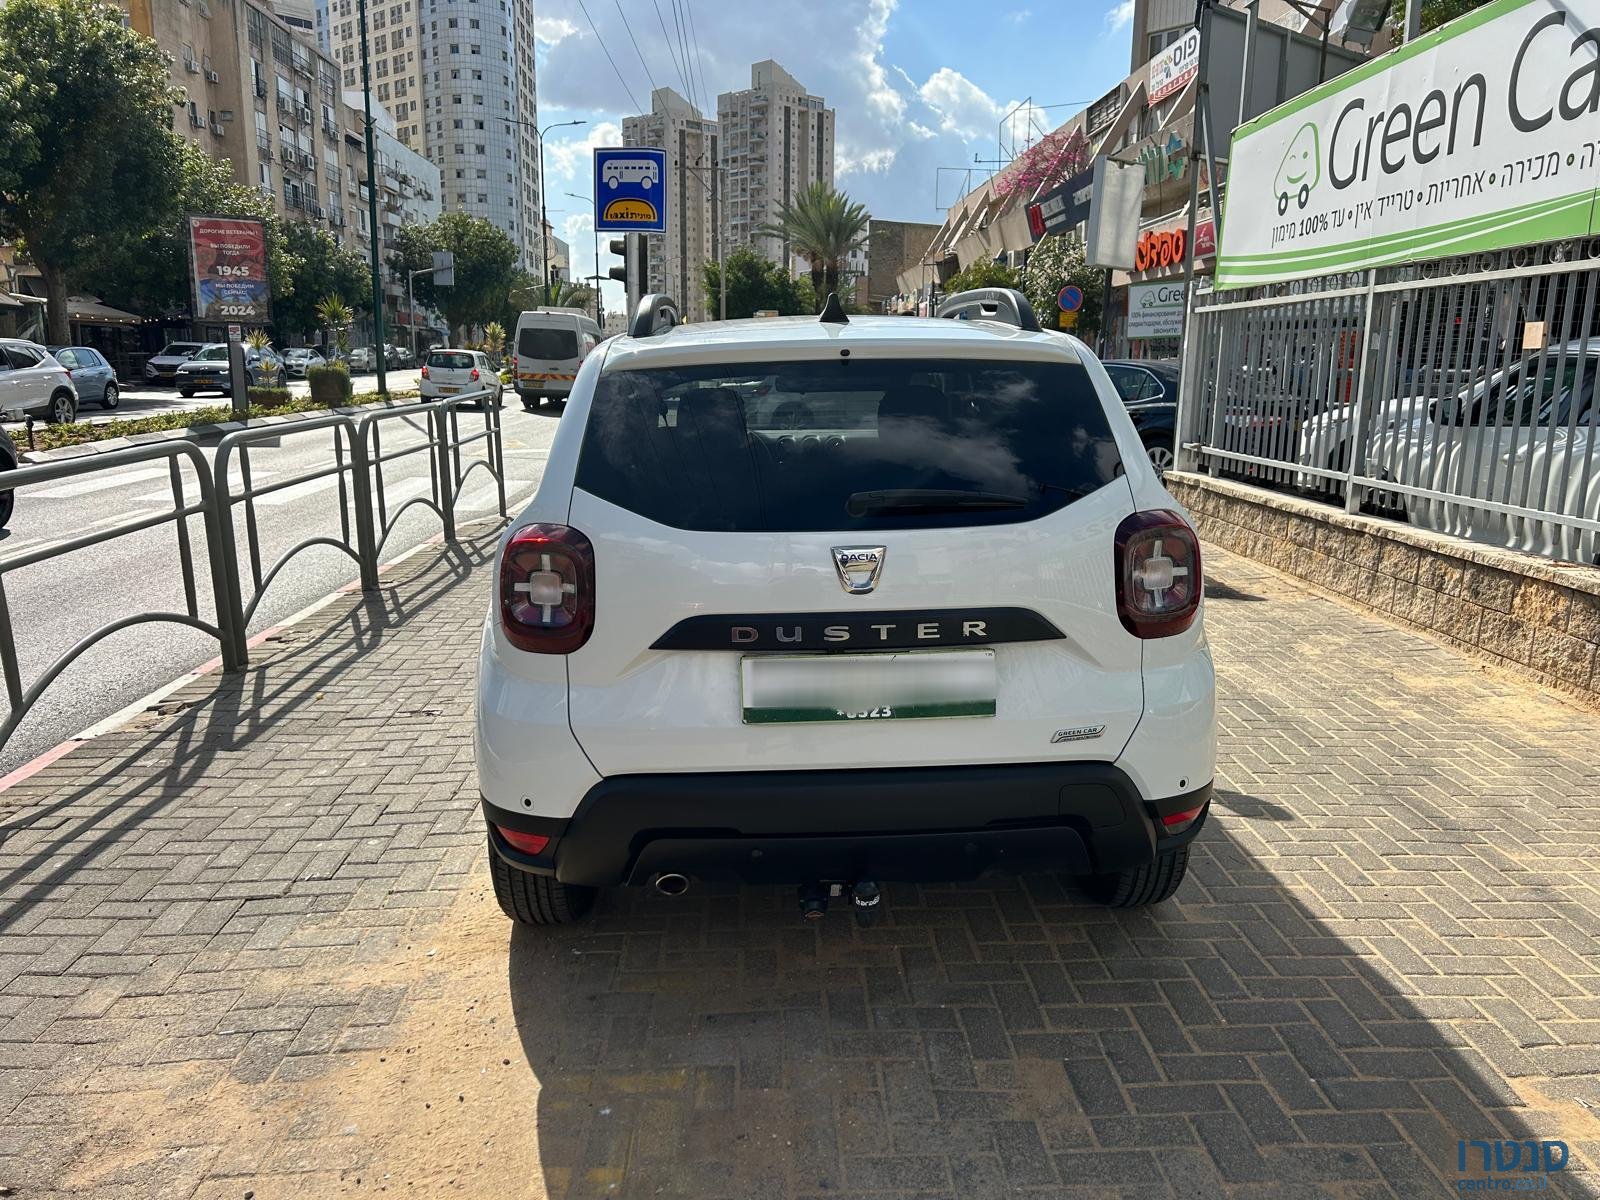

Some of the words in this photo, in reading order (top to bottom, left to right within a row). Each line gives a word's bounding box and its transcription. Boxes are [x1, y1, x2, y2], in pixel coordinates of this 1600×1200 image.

[1328, 73, 1487, 190] Green
[1500, 151, 1560, 187] מכירה
[1426, 169, 1487, 206] אחריות
[1354, 198, 1374, 229] אין
[1377, 188, 1414, 217] טרייד
[1298, 210, 1328, 238] 100%
[1332, 206, 1346, 229] עד
[1271, 220, 1296, 249] מימון
[216, 265, 250, 276] 1945
[220, 305, 256, 315] 2024
[841, 553, 878, 562] DACIA
[731, 620, 988, 643] DUSTER
[1058, 729, 1082, 737] GREEN
